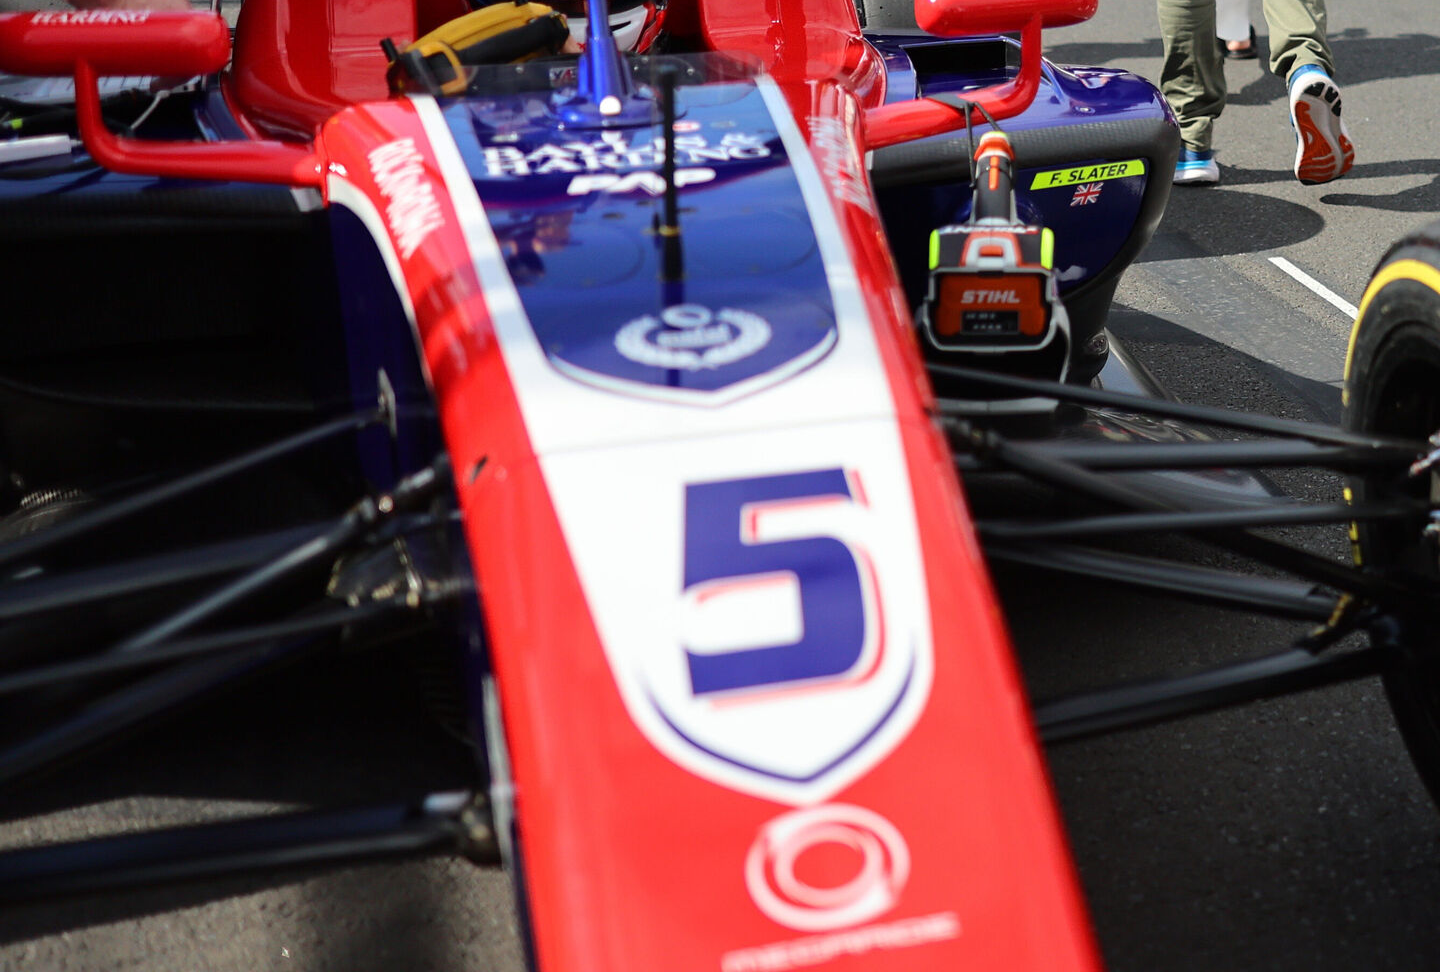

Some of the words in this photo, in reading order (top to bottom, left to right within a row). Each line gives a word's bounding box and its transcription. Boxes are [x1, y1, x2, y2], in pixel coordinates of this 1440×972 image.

[1050, 172, 1063, 185] F.
[1067, 164, 1129, 182] SLATER
[961, 289, 1021, 304] STIHL
[681, 466, 884, 706] 5
